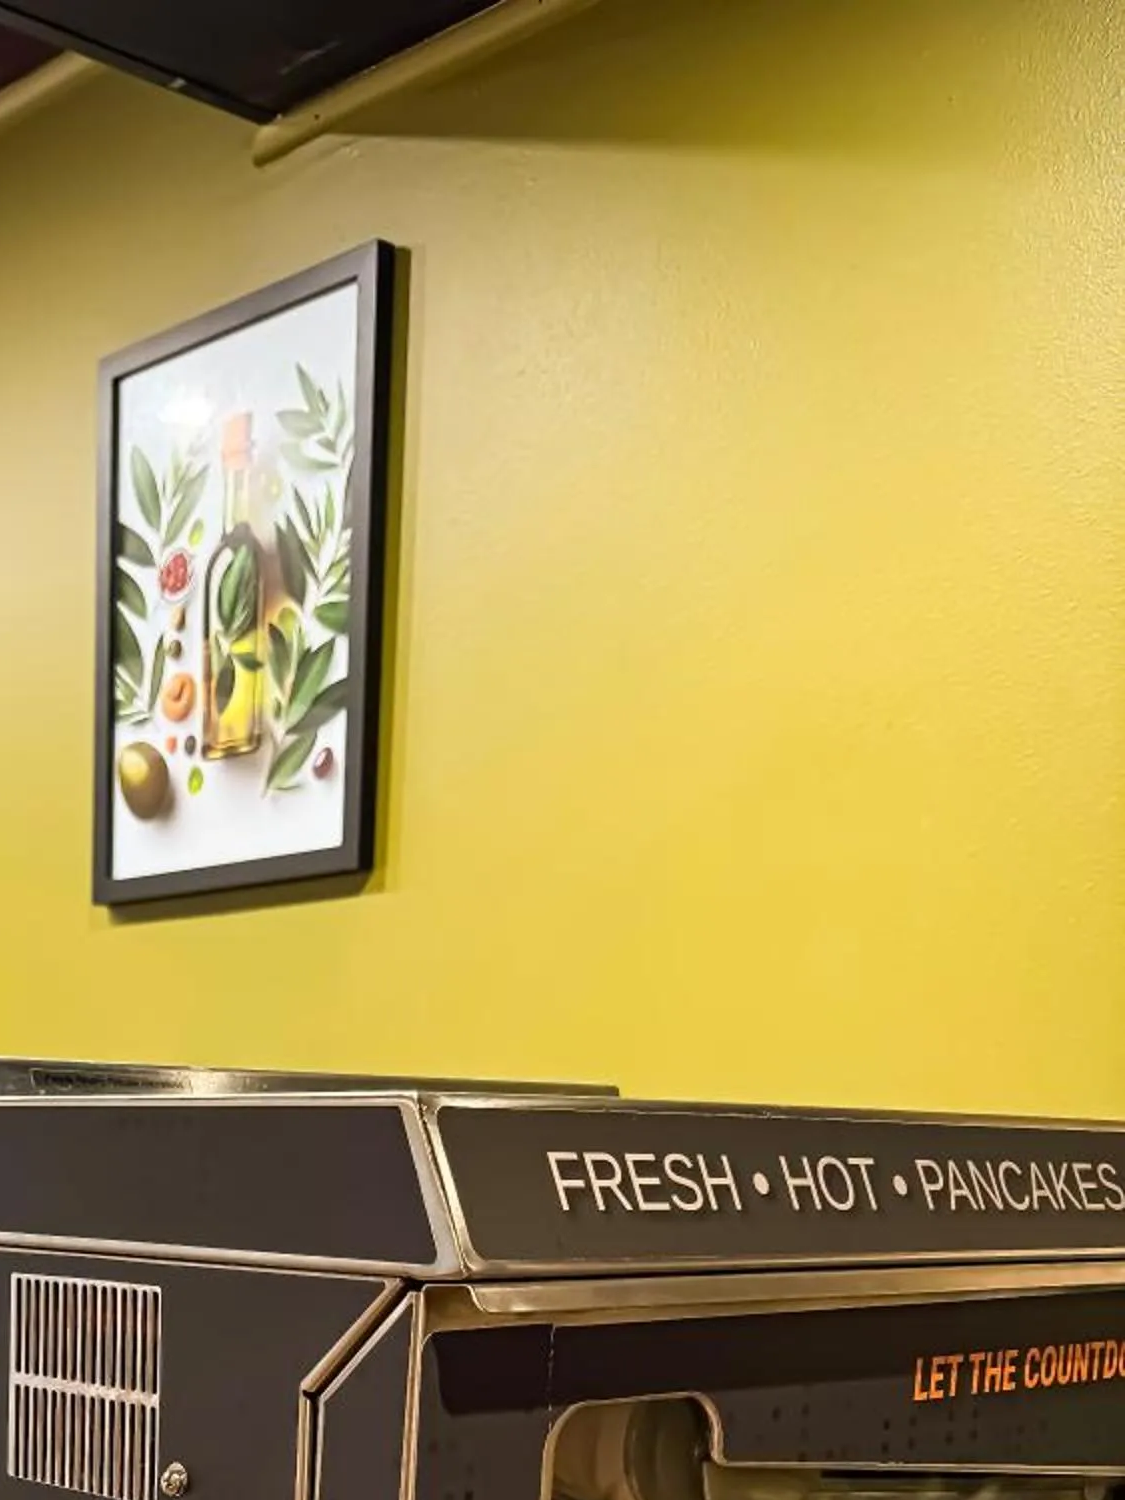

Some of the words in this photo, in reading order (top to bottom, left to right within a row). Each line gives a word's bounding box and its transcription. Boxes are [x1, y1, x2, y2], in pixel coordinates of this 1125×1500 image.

[546, 1150, 743, 1212] FRESH
[778, 1155, 878, 1212] HOT
[913, 1158, 1125, 1211] PANCAKES
[913, 1354, 964, 1401] LET
[969, 1349, 1019, 1395] THE
